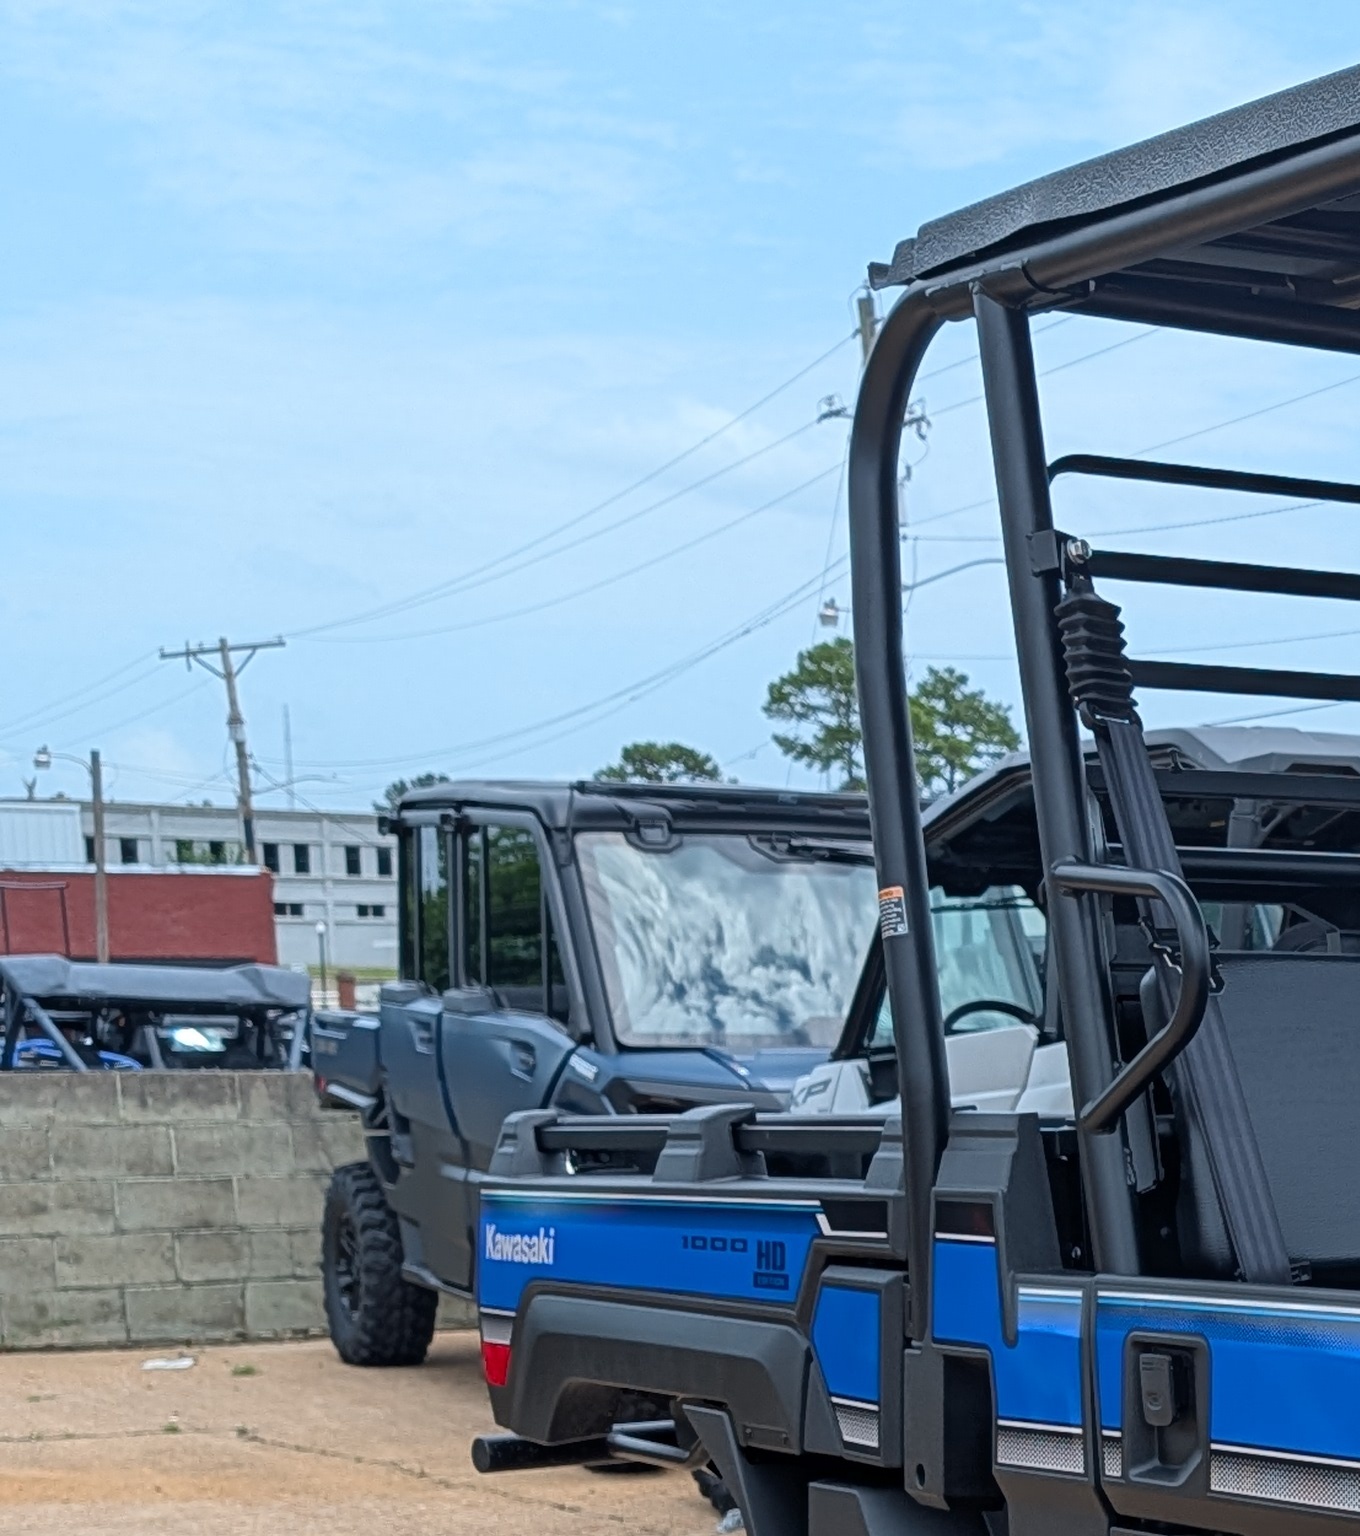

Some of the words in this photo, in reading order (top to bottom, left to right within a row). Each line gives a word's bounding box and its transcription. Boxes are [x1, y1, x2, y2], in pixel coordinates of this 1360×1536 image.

[485, 1222, 555, 1265] Kawasaki
[682, 1235, 748, 1253] 1000
[756, 1240, 786, 1272] HD
